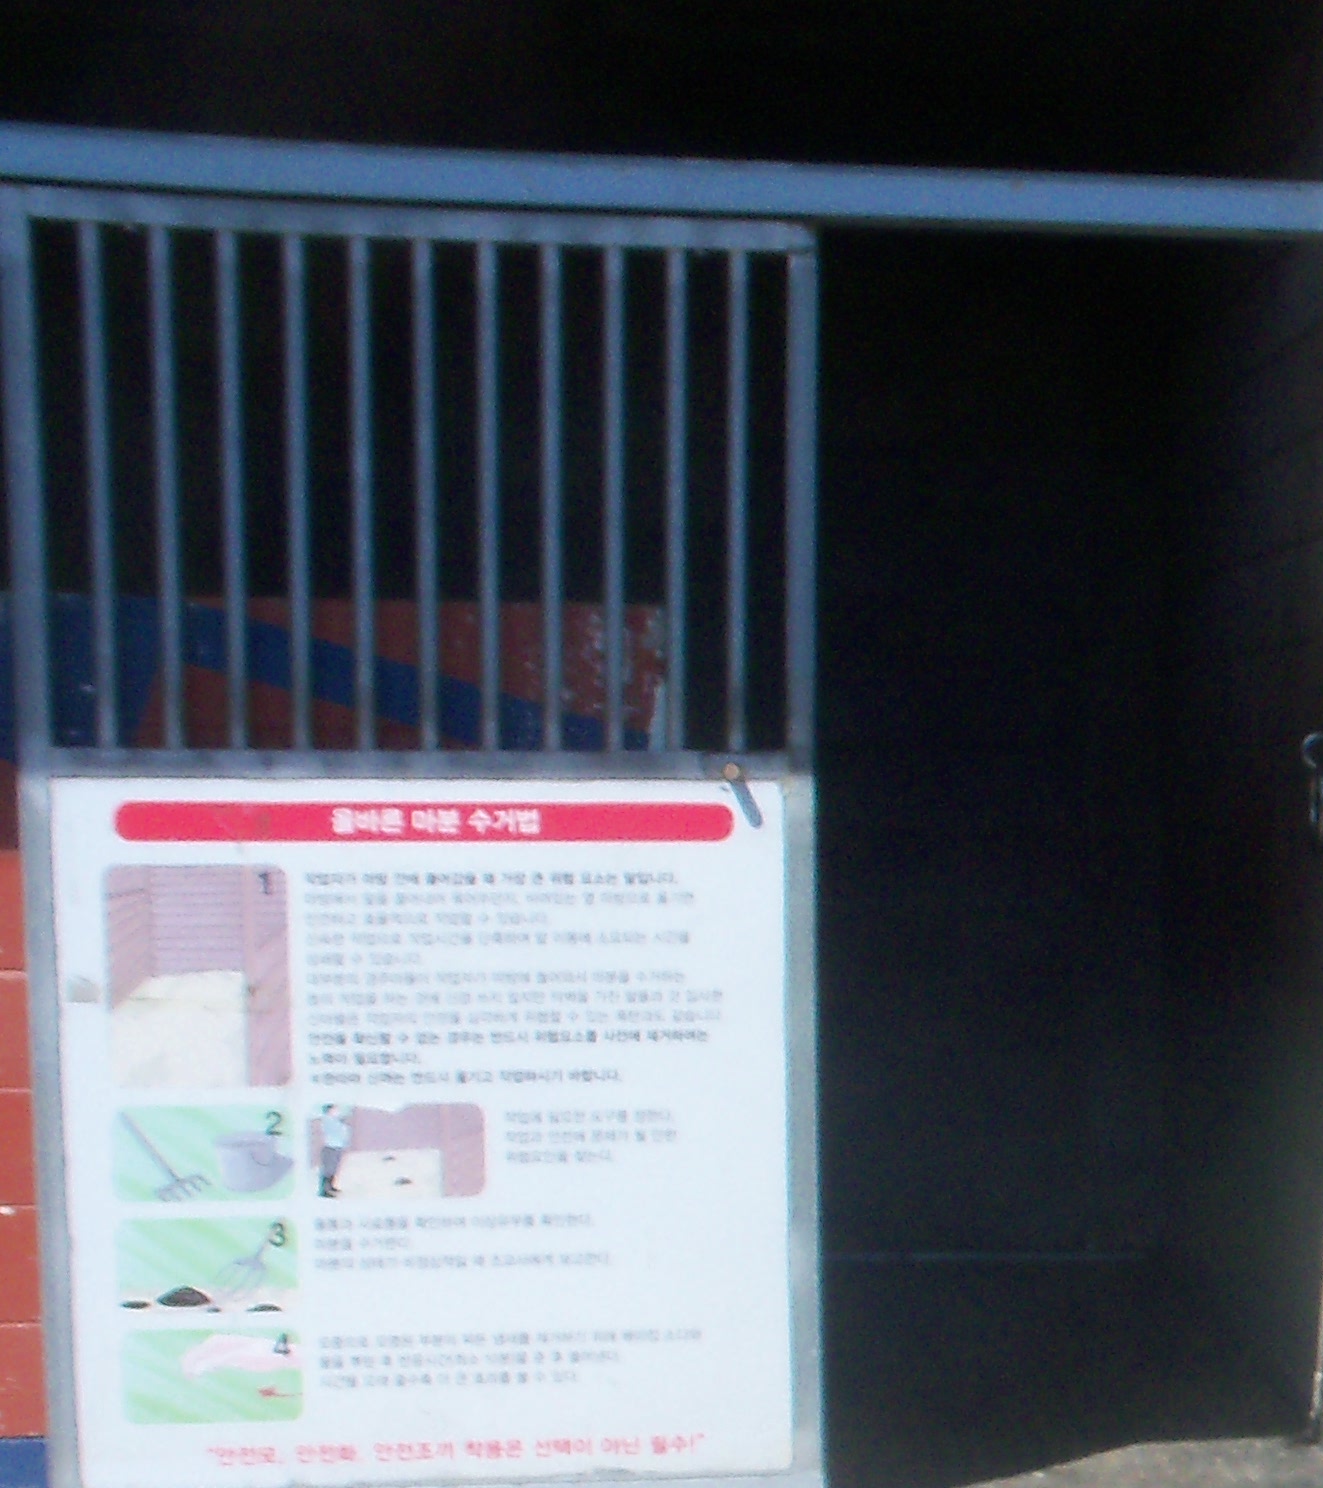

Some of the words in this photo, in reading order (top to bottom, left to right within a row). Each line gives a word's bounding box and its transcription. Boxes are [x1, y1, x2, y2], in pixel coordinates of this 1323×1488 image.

[332, 808, 403, 836] 올바른
[411, 809, 460, 835] 마분
[468, 808, 541, 835] 수거법
[258, 873, 272, 894] 1
[265, 1111, 282, 1136] 2
[270, 1222, 286, 1247] 3
[275, 1333, 290, 1354] 4
